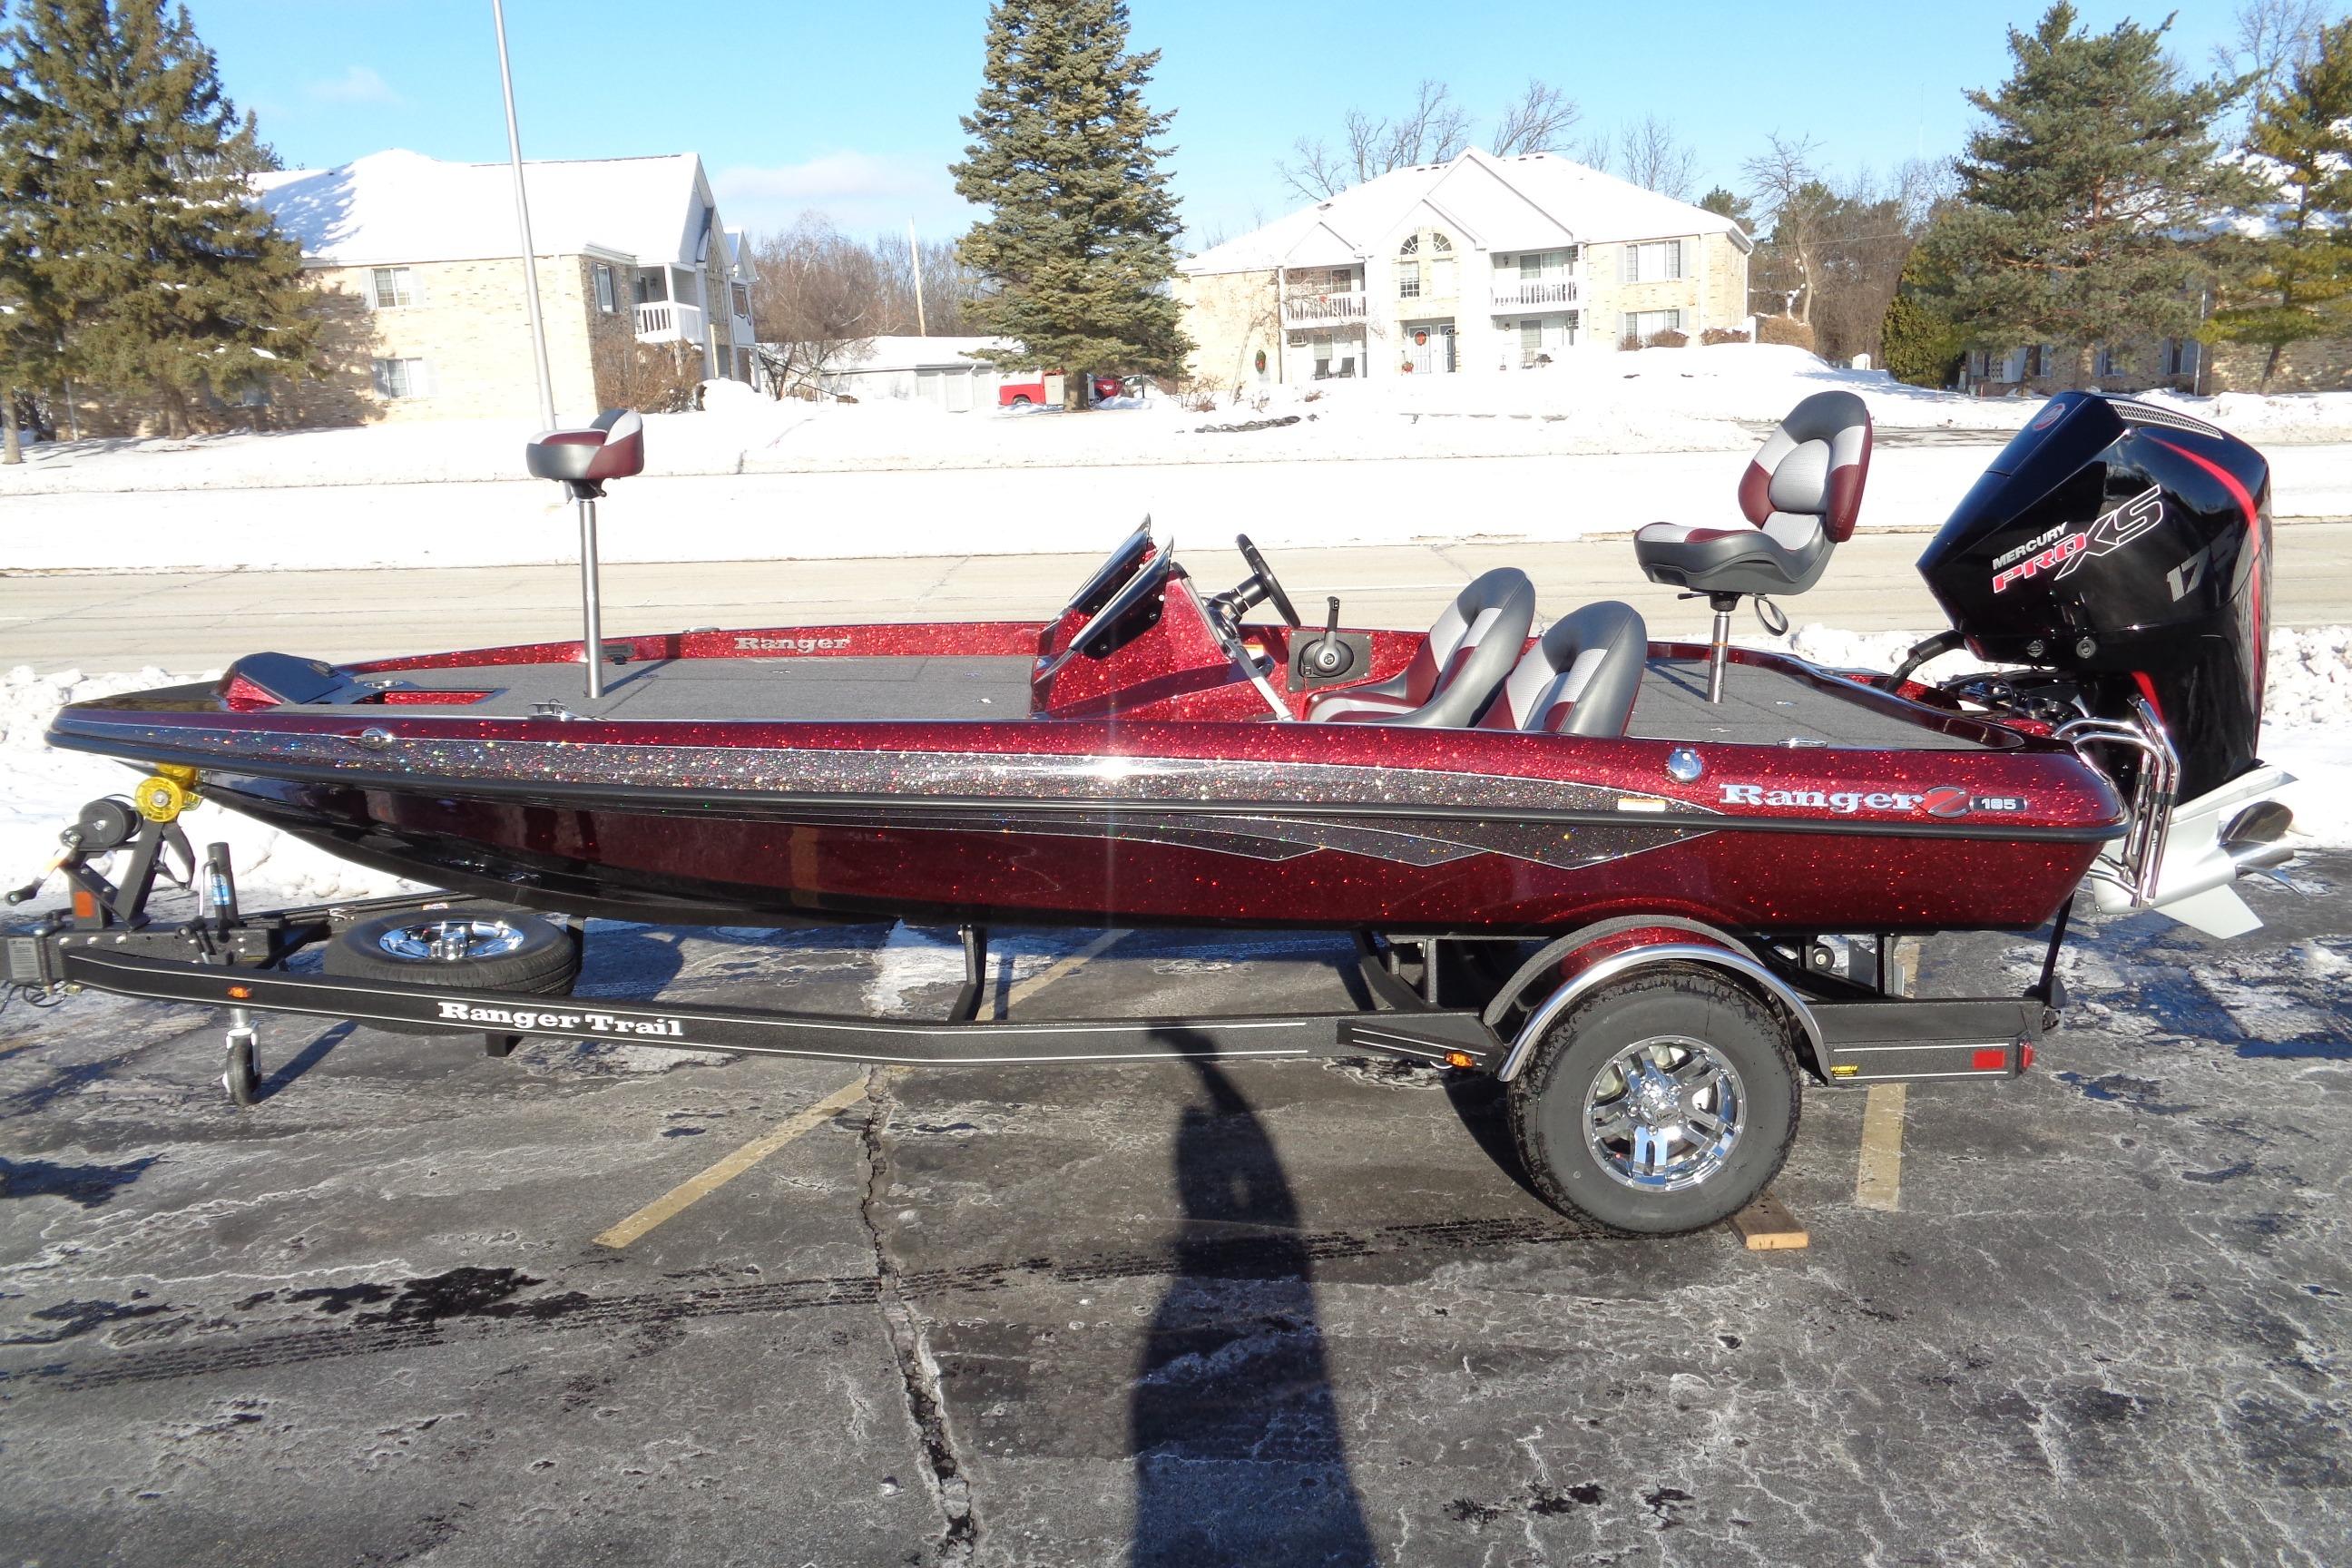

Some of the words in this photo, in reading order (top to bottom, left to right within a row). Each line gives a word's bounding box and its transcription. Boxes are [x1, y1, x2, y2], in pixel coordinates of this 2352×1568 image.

[1992, 521, 2069, 571] MERCURY
[1992, 532, 2088, 594] PRO
[733, 636, 851, 653] Ranger
[1719, 783, 1925, 814] Ranger
[1981, 798, 2017, 810] 185
[436, 1001, 581, 1029] Ranger
[584, 1014, 683, 1036] Trail
